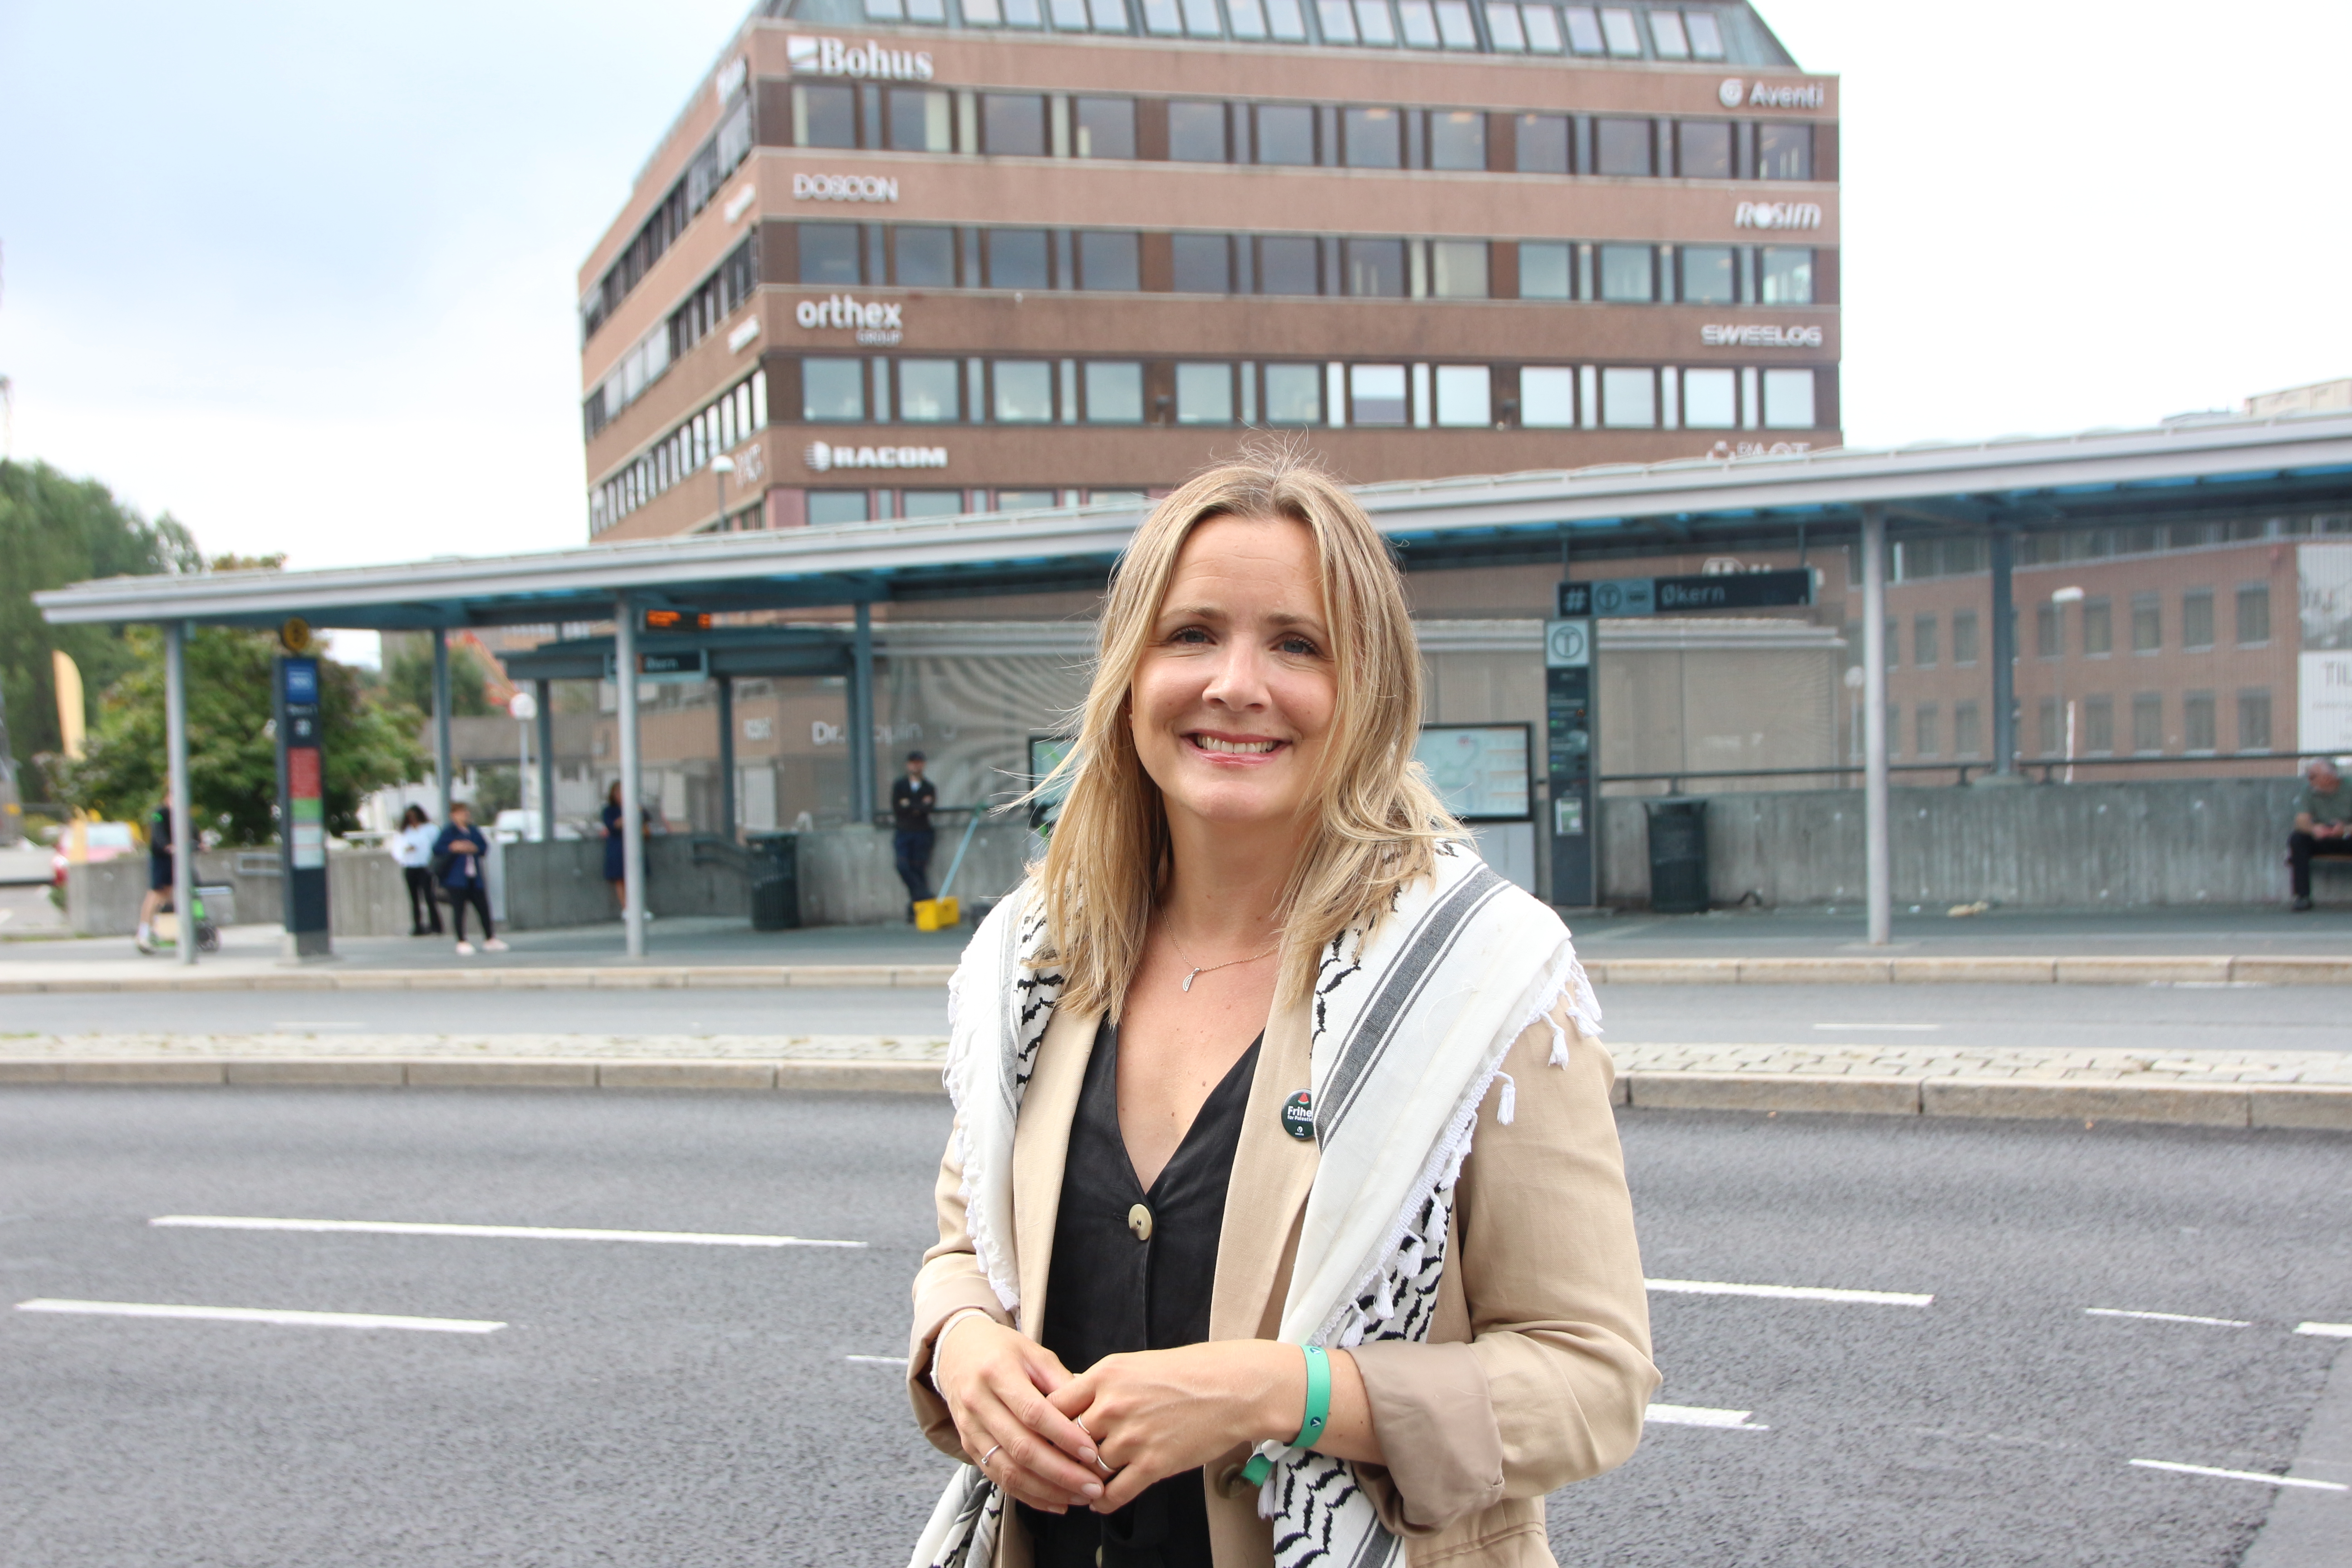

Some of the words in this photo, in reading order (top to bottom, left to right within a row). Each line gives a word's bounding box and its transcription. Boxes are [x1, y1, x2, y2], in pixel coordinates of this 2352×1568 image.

[818, 37, 934, 80] Bohus
[1749, 80, 1823, 108] Aventi
[794, 173, 898, 203] DOSCON
[796, 294, 902, 329] orthex
[1661, 584, 1725, 605] Økern
[1288, 1106, 1312, 1117] Frihe
